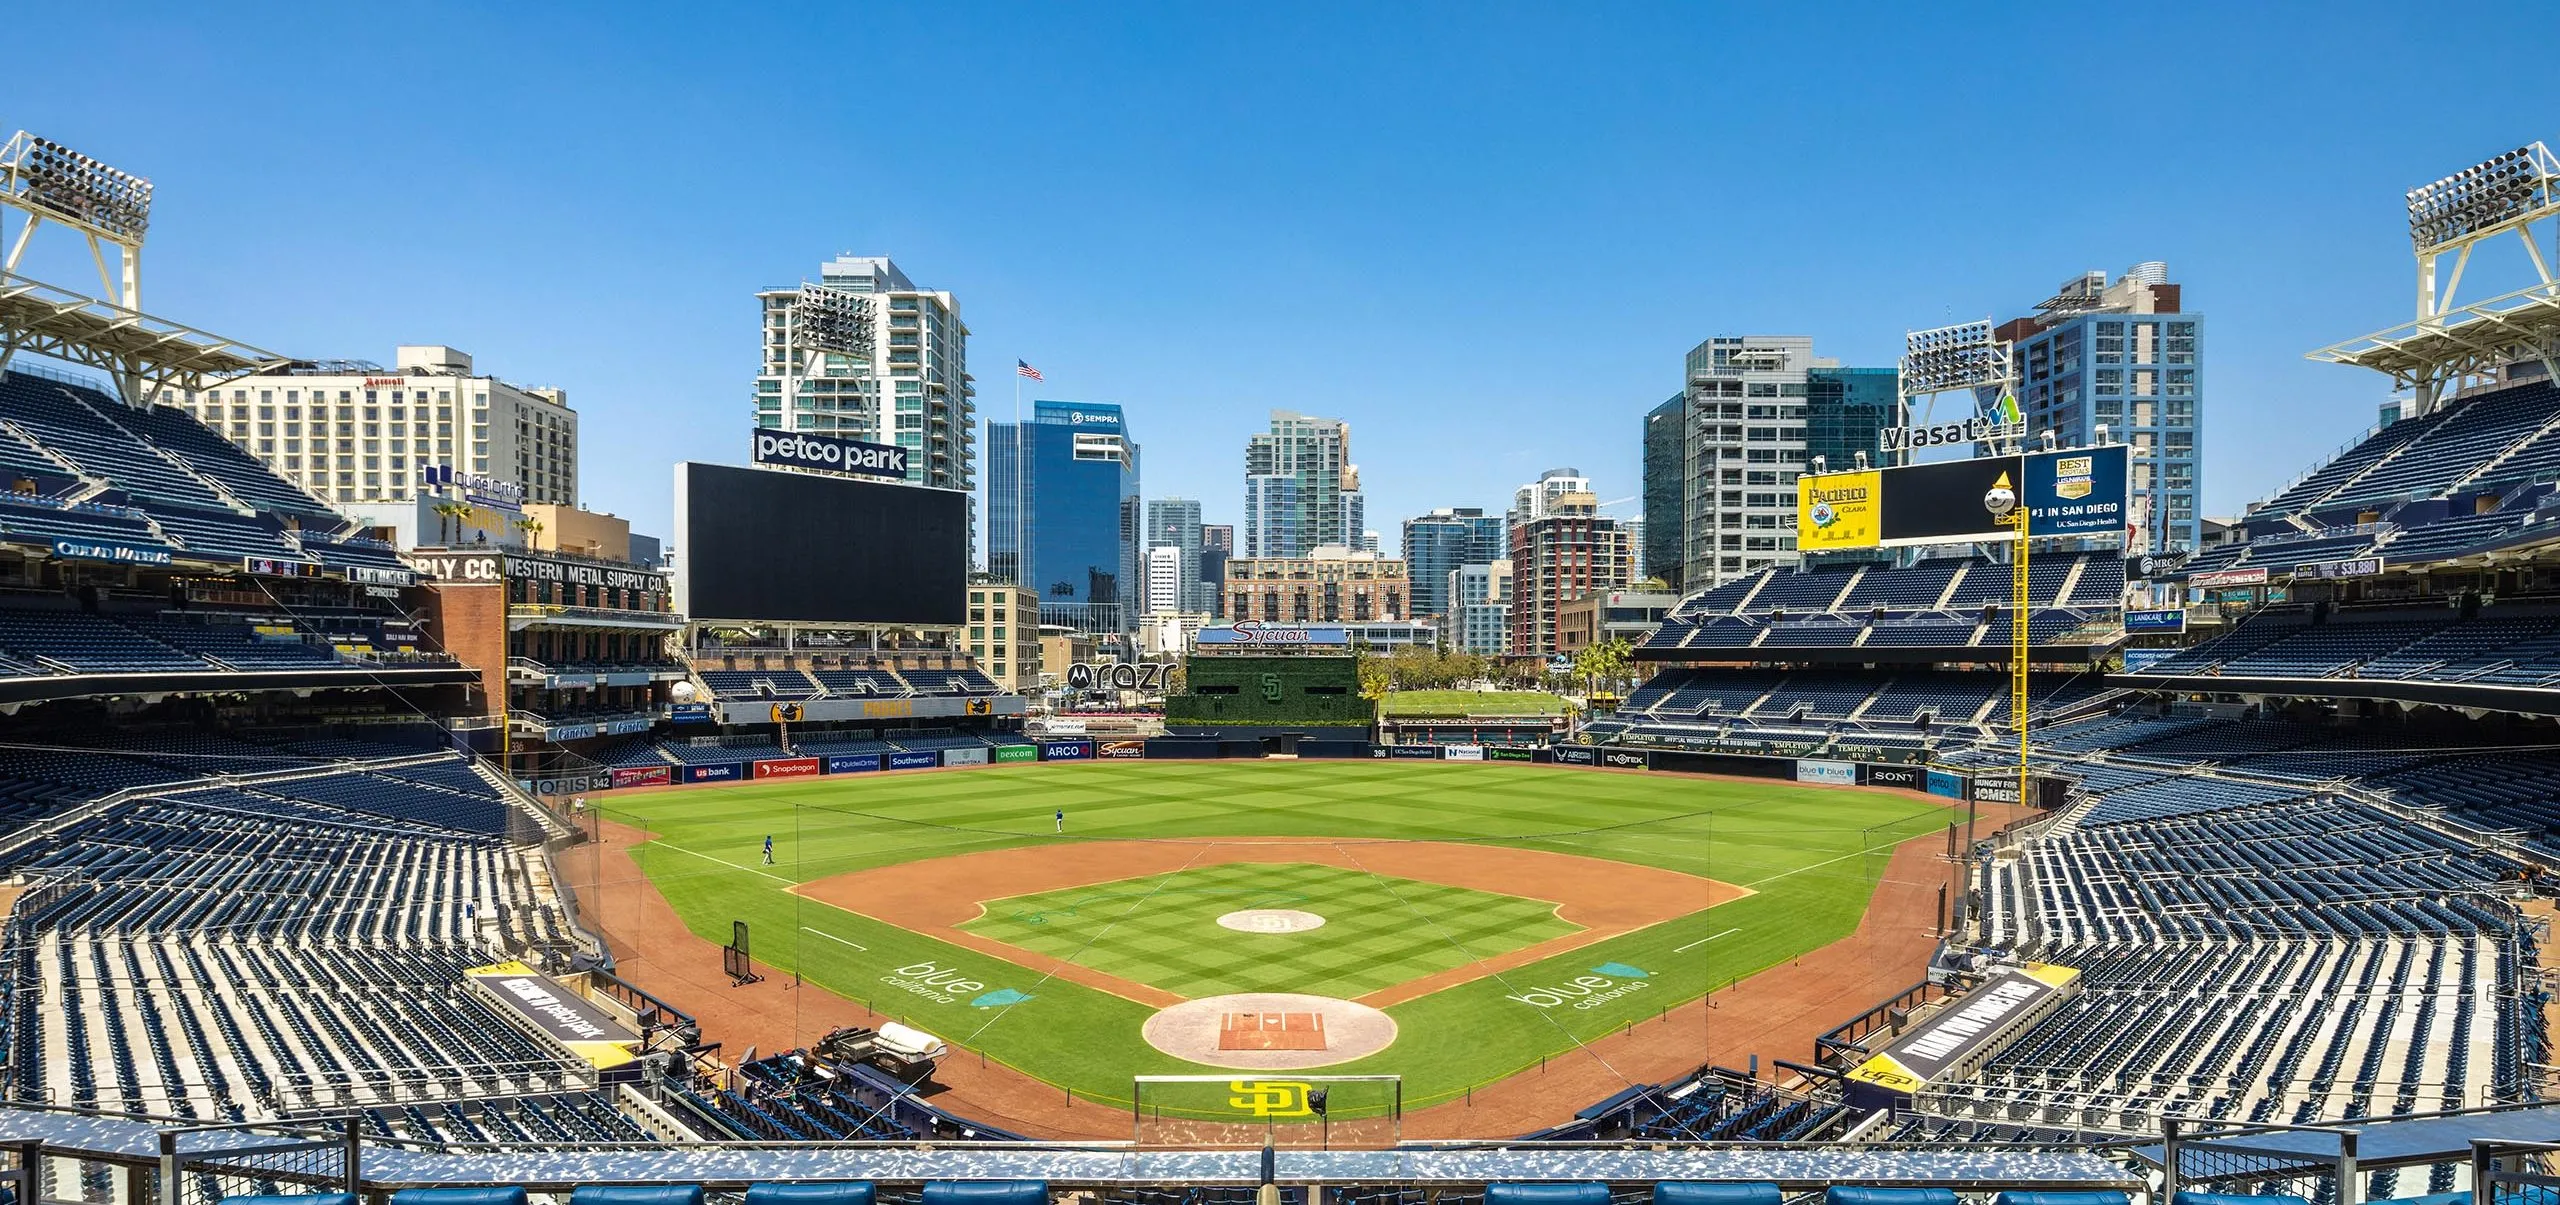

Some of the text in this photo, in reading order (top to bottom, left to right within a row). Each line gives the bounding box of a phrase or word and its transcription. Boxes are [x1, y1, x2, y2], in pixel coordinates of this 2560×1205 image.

[364, 378, 404, 387] Marriott
[1084, 415, 1118, 424] SEMPRA
[1884, 418, 1978, 450] Viasat
[758, 434, 905, 471] petco park
[2059, 459, 2090, 470] BEST
[454, 471, 522, 499] QuidelOrtho
[1808, 488, 1867, 506] PACIFICO
[2032, 502, 2118, 518] #1 IN SAN DIEGO
[2080, 519, 2096, 528] Diego
[58, 542, 113, 558] CIUDAD
[464, 558, 501, 580] CO.
[2154, 558, 2174, 568] MRC
[2342, 560, 2376, 576] $31,880
[504, 557, 664, 592] WESTERN METAL SUPPLY CO.
[366, 586, 400, 598] SPIRITS
[1231, 620, 1310, 648] Sycuan
[1096, 663, 1178, 689] razr
[864, 701, 912, 717] PADRES
[1622, 734, 1656, 742] TEMPLETON
[1048, 746, 1079, 756] ARCO
[1100, 742, 1140, 757] Sycuan
[1770, 742, 1812, 750] TEMPLETON
[1838, 746, 1882, 754] TEMPLETON
[1374, 750, 1386, 758] 396
[1607, 754, 1644, 764] EVOTEK
[841, 760, 878, 768] QuidelOrtho
[892, 756, 929, 766] Southwest
[696, 768, 730, 777] us bank
[772, 764, 816, 773] Snapdragon
[592, 778, 610, 788] 342
[1875, 772, 1914, 782] SONY
[1929, 776, 1950, 789] petco
[1974, 779, 2018, 788] HUNGRY FOR
[540, 778, 587, 794] ORIS
[1975, 788, 2021, 802] HOMERS
[893, 961, 985, 994] blue
[880, 976, 956, 1004] california
[1505, 976, 1613, 1008] blue
[1573, 980, 1650, 1010] california
[534, 1000, 606, 1038] petco park
